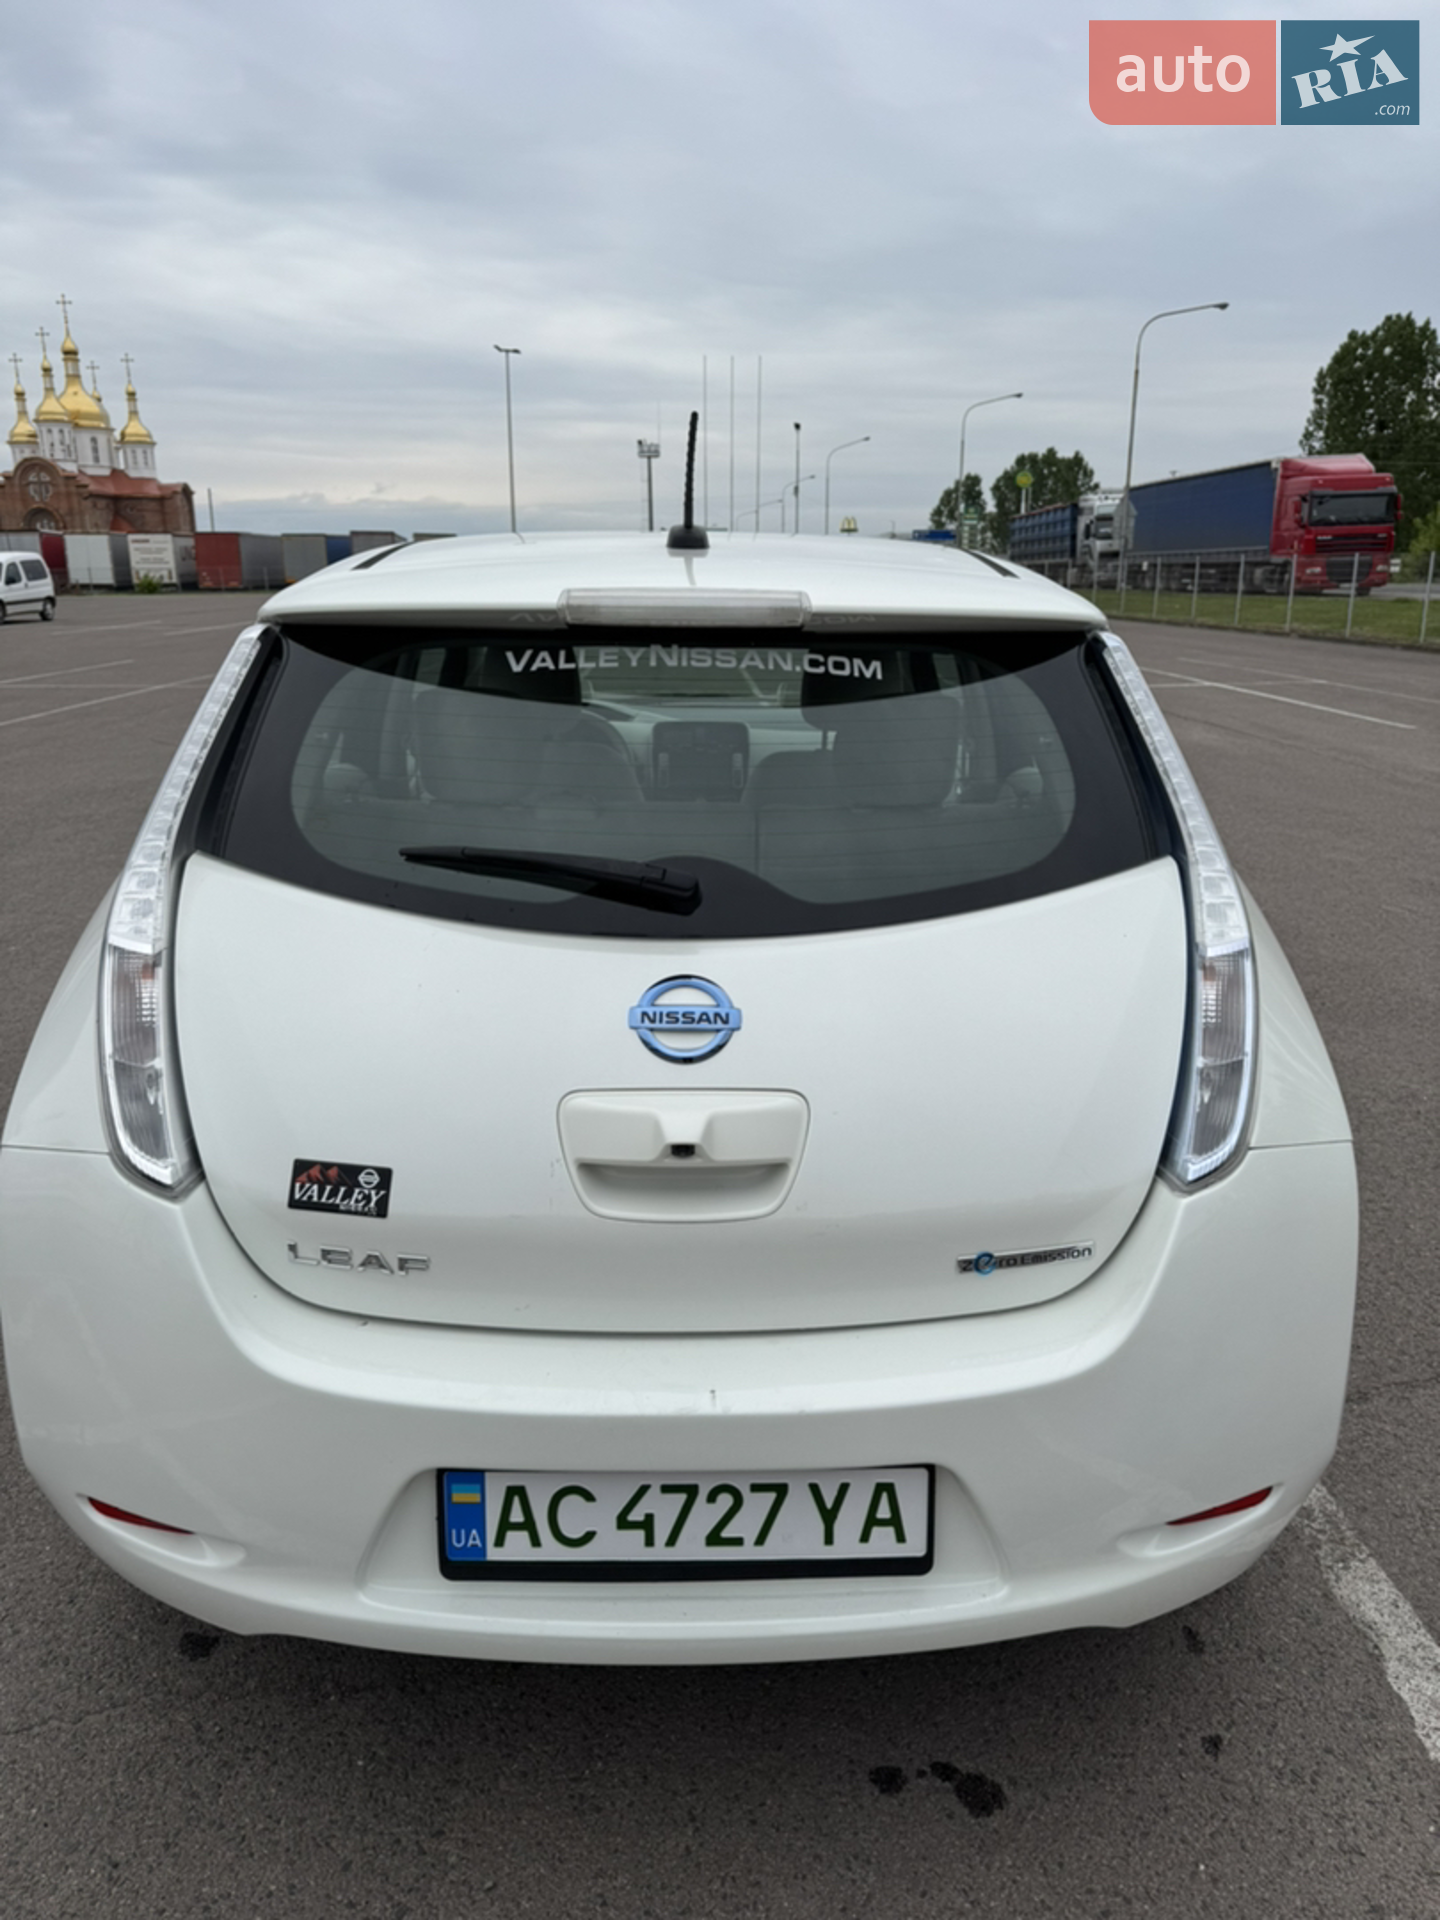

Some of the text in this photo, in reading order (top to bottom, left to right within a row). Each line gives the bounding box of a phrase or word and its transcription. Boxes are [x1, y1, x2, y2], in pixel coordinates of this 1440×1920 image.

[640, 1010, 730, 1025] NISSAN
[293, 1182, 386, 1208] VALLEY
[287, 1241, 430, 1275] LEAF
[1021, 1246, 1092, 1266] Emission
[493, 1481, 907, 1549] AC 4727 YA
[451, 1528, 482, 1549] UA
